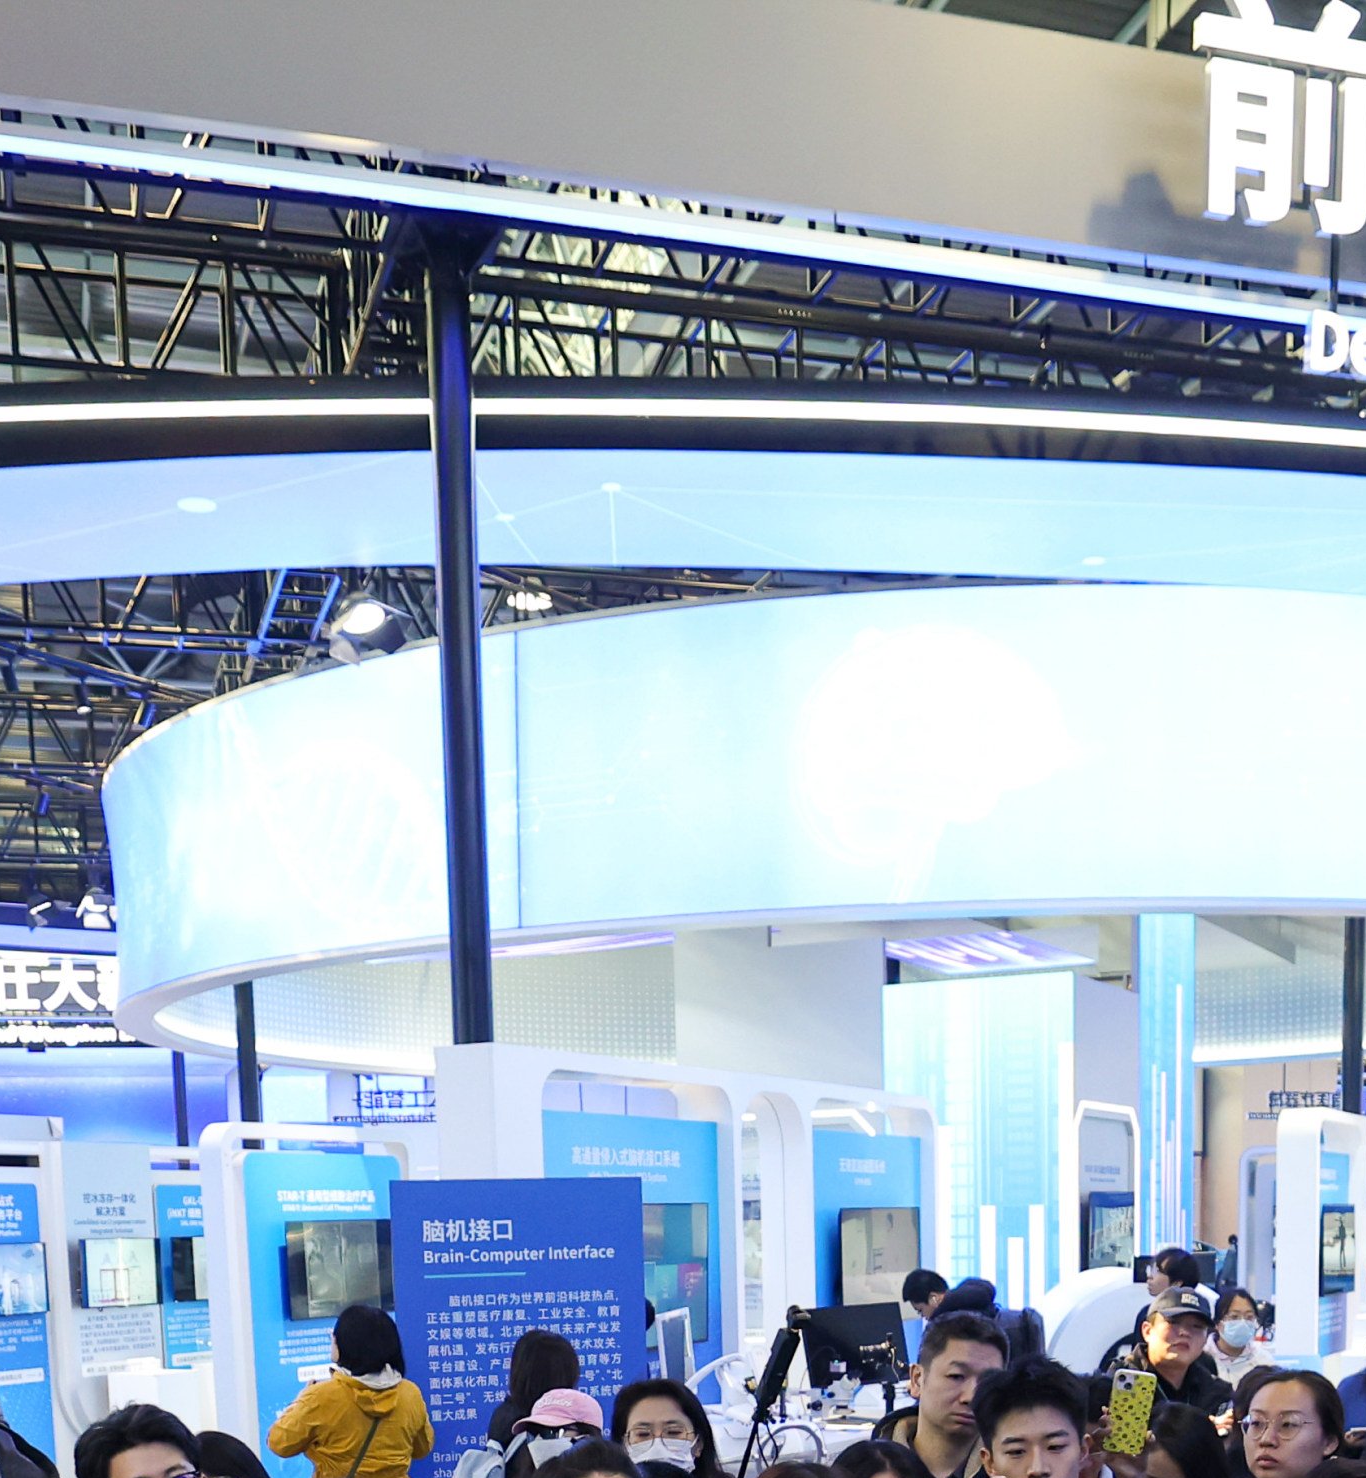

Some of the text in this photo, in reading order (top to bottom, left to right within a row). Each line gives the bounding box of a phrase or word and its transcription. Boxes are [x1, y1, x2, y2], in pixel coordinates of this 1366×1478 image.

[422, 1218, 513, 1243] 脑机接口
[423, 1245, 615, 1264] Brain-Computer Interface
[428, 1341, 515, 1358] 展机遇，发布行
[429, 1374, 509, 1390] 面体系化布局，
[431, 1408, 477, 1421] 重大成果
[455, 1434, 467, 1445] As
[470, 1436, 477, 1444] a
[433, 1467, 454, 1478] sha
